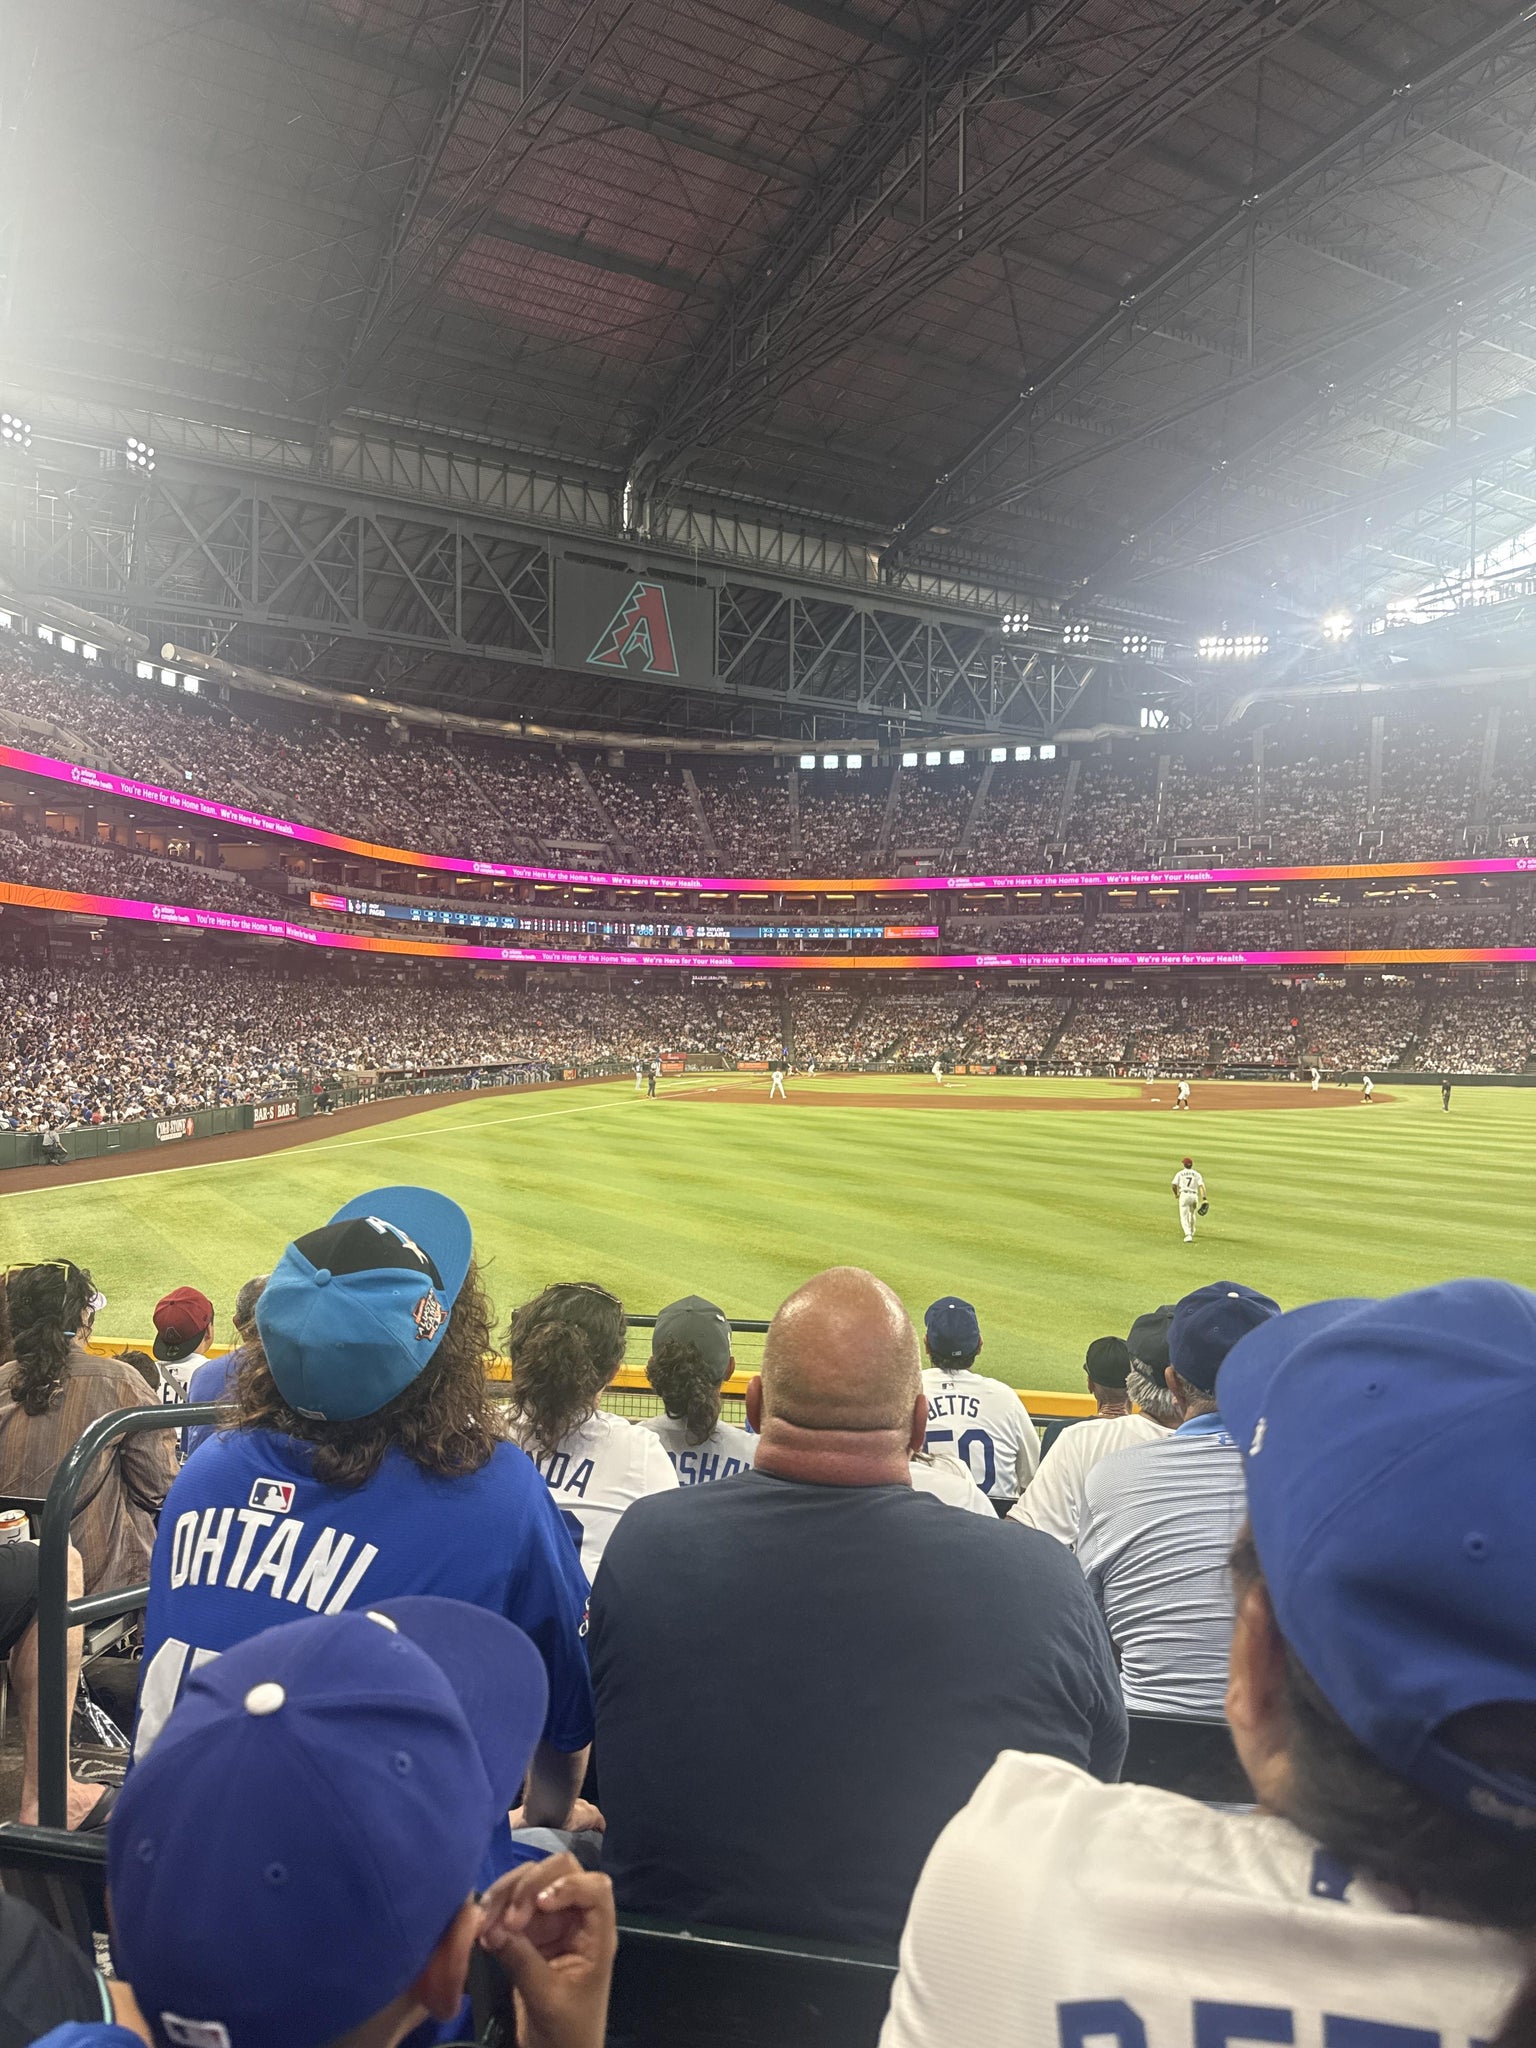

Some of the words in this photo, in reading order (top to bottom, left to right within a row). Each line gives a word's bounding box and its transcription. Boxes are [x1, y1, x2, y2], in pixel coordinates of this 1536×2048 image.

[120, 783, 141, 795] You're
[143, 789, 158, 800] Here
[160, 792, 168, 802] for
[170, 795, 180, 805] the
[182, 798, 199, 810] Home
[200, 804, 217, 815] Team.
[220, 809, 238, 820] We're
[239, 814, 252, 824] Here
[253, 816, 261, 825] for
[262, 820, 275, 830] Your
[275, 823, 294, 835] Health.
[532, 870, 546, 878] Here
[548, 871, 556, 879] for
[679, 880, 703, 888] Health.
[993, 878, 1013, 886] You're
[1151, 873, 1162, 881] for
[196, 914, 215, 924] You're
[216, 917, 230, 926] Here
[231, 918, 240, 928] for
[241, 920, 250, 929] the
[252, 922, 268, 932] Home
[269, 925, 284, 933] Team.
[1018, 956, 1040, 964] You're
[1217, 954, 1247, 962] Health.
[254, 1106, 274, 1121] BAR-S
[278, 1102, 296, 1117] BAR-S
[1186, 1177, 1192, 1187] 7
[171, 1507, 379, 1615] OHTANI
